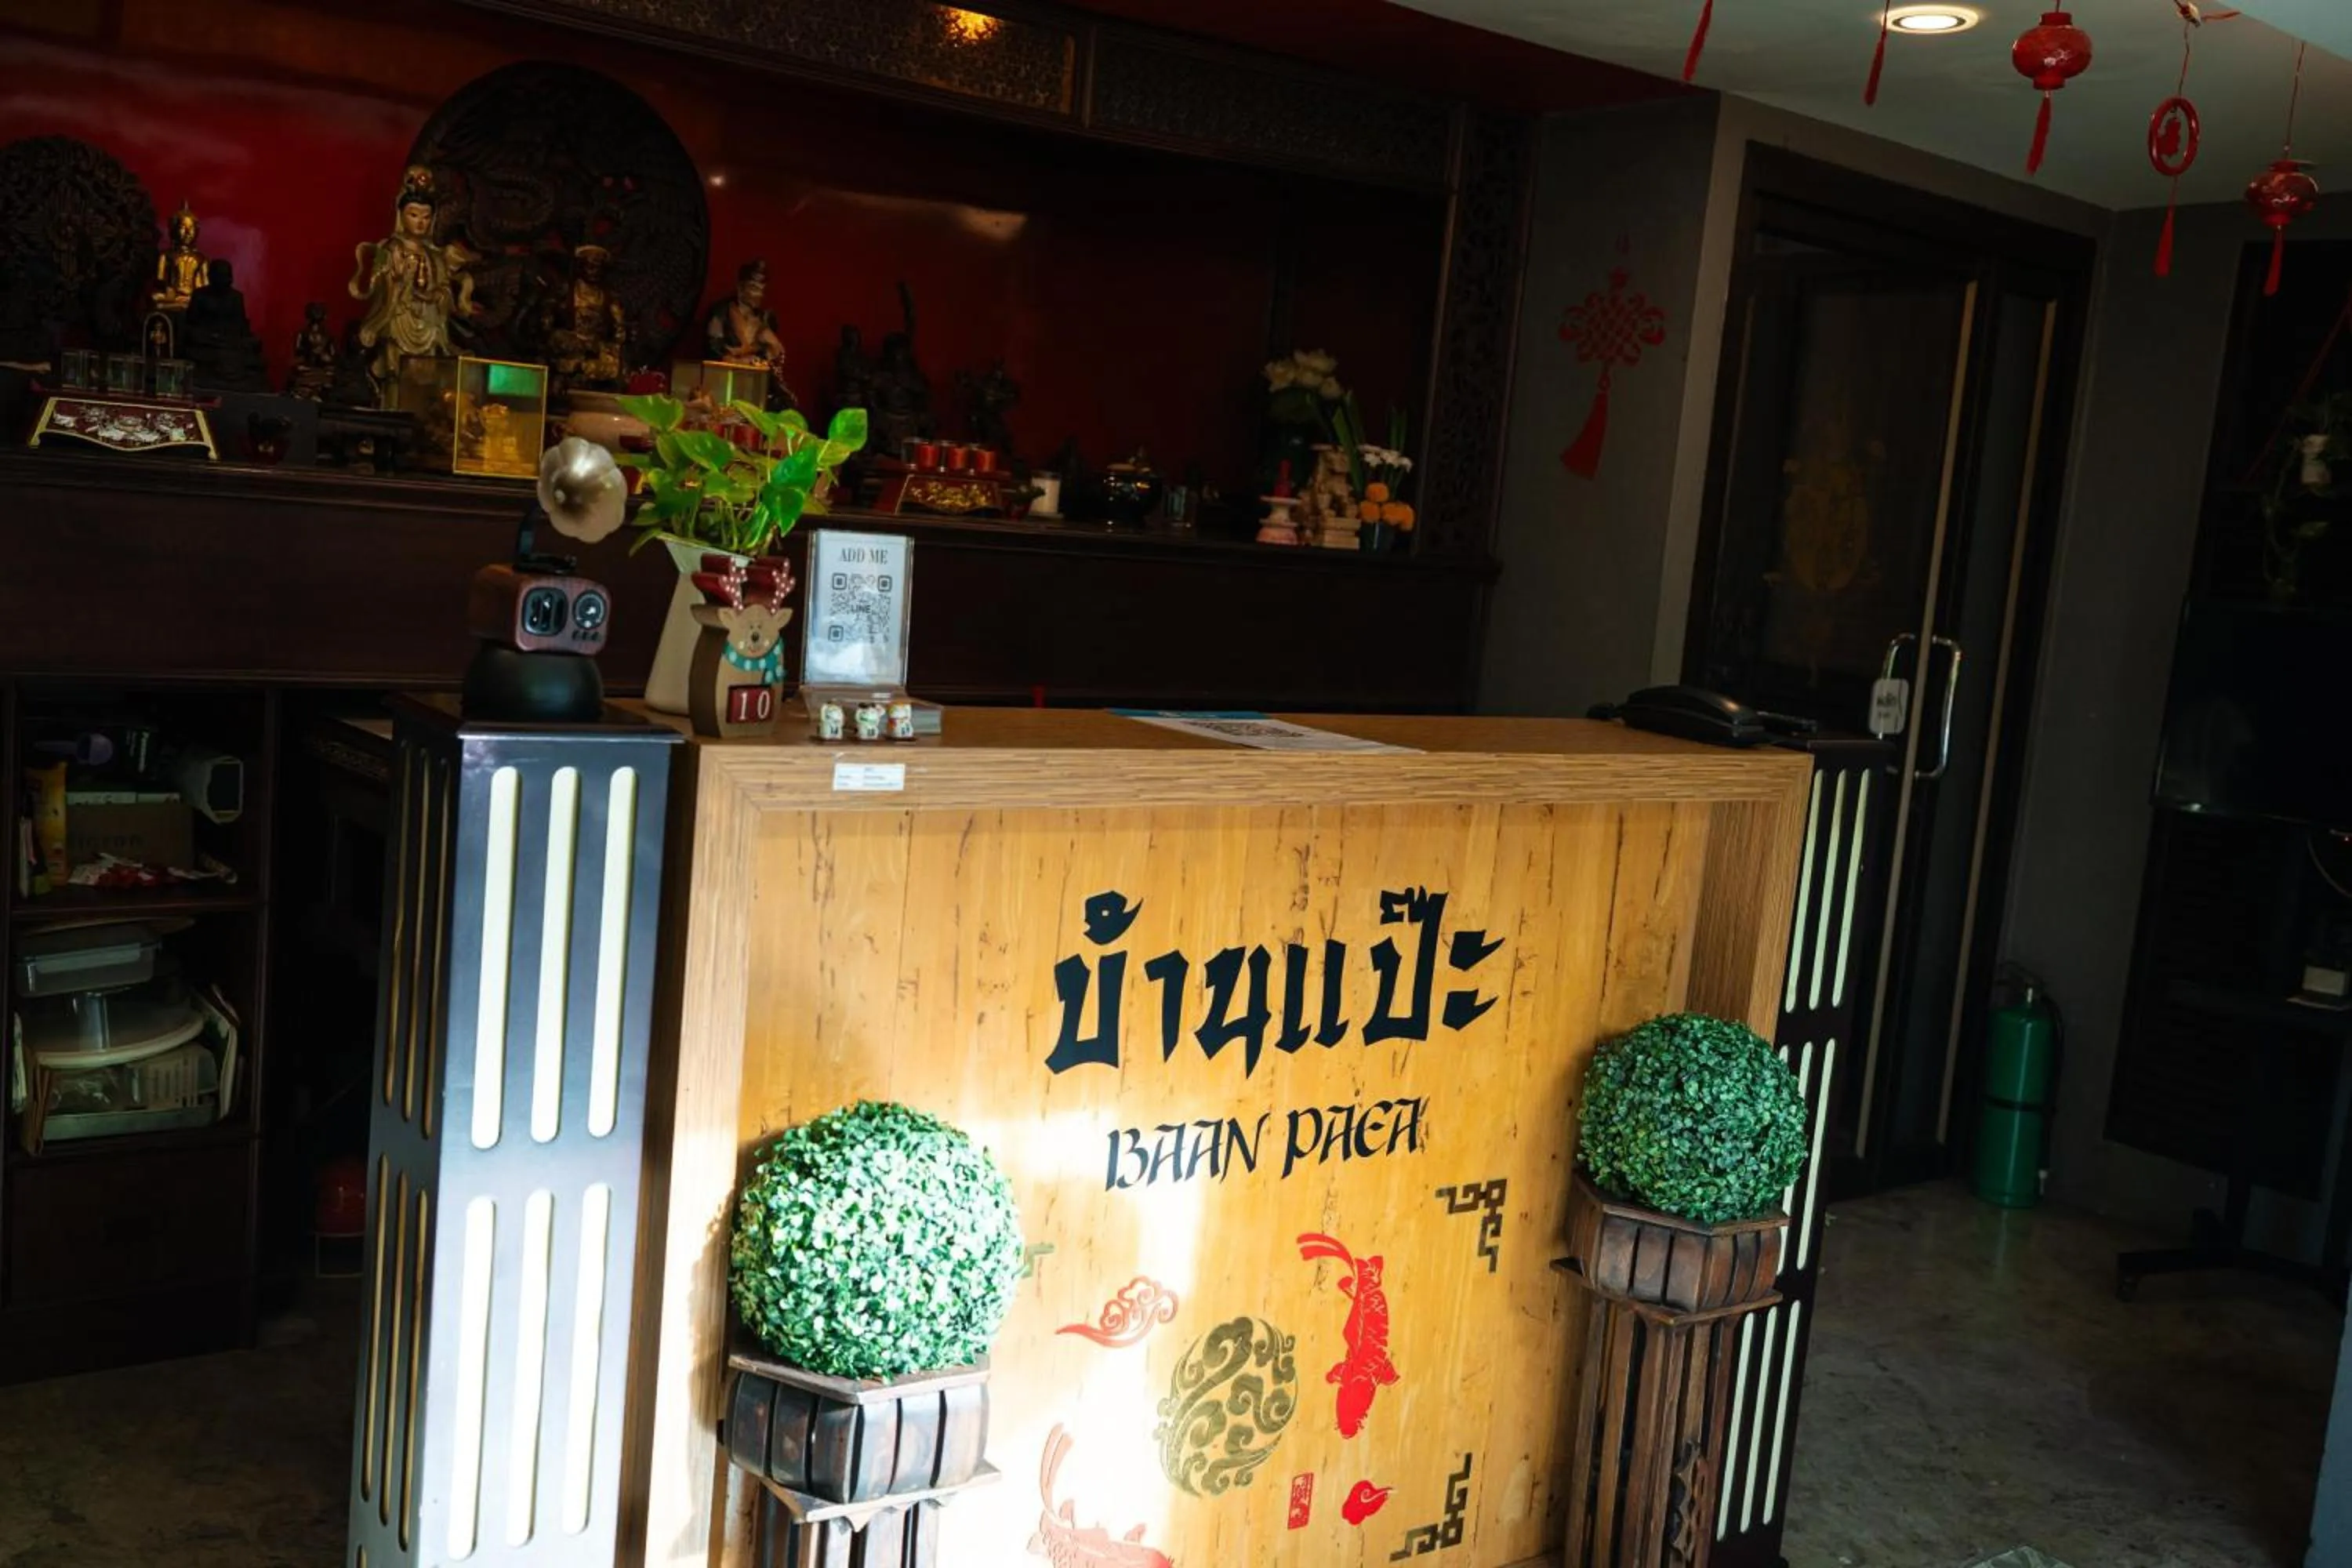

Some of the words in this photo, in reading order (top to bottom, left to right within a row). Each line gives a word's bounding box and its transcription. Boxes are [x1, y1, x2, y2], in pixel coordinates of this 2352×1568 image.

[839, 547, 865, 563] ADD
[868, 550, 888, 564] ME
[851, 603, 871, 614] LINE
[1105, 1113, 1270, 1191] BAAN
[1281, 1097, 1421, 1179] PAEA
